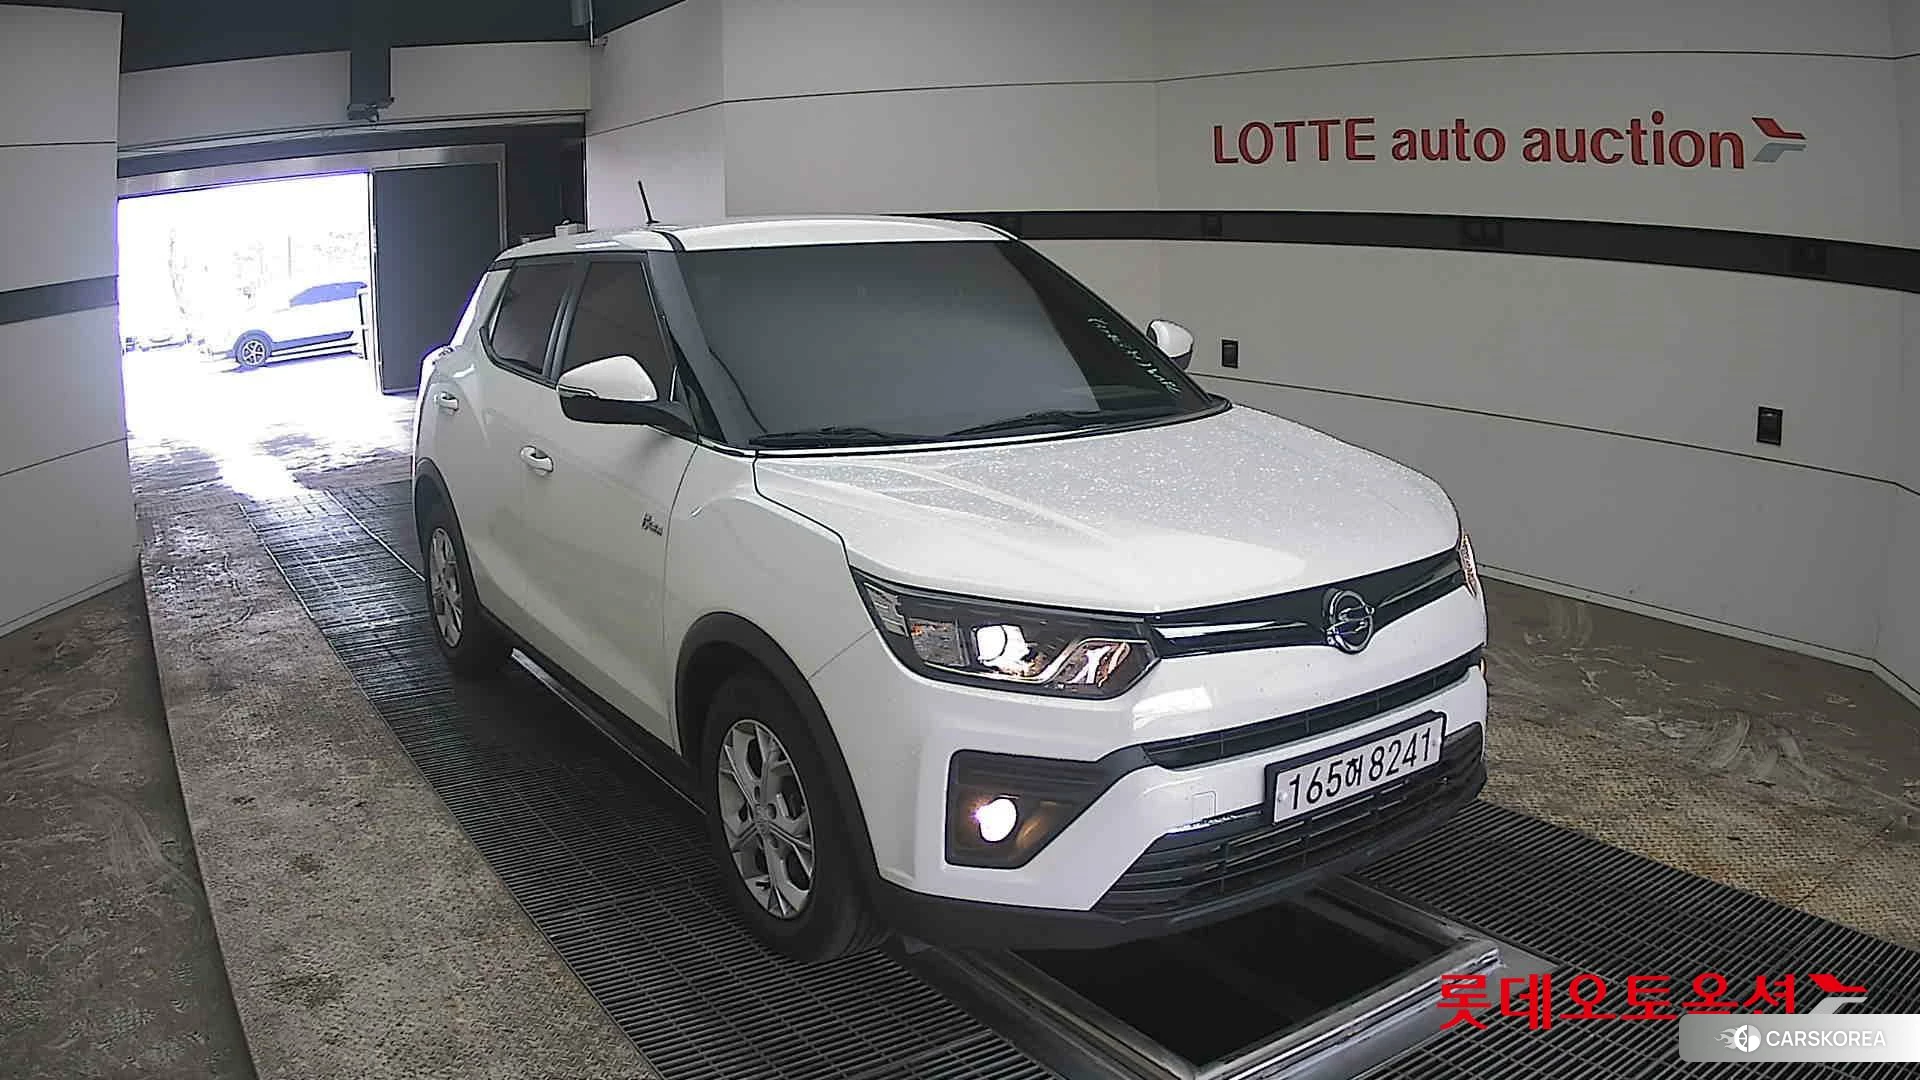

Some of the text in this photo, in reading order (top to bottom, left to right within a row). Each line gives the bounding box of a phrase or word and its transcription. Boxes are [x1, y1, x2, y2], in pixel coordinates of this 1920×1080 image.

[1213, 110, 1745, 170] LOTTE auto auction
